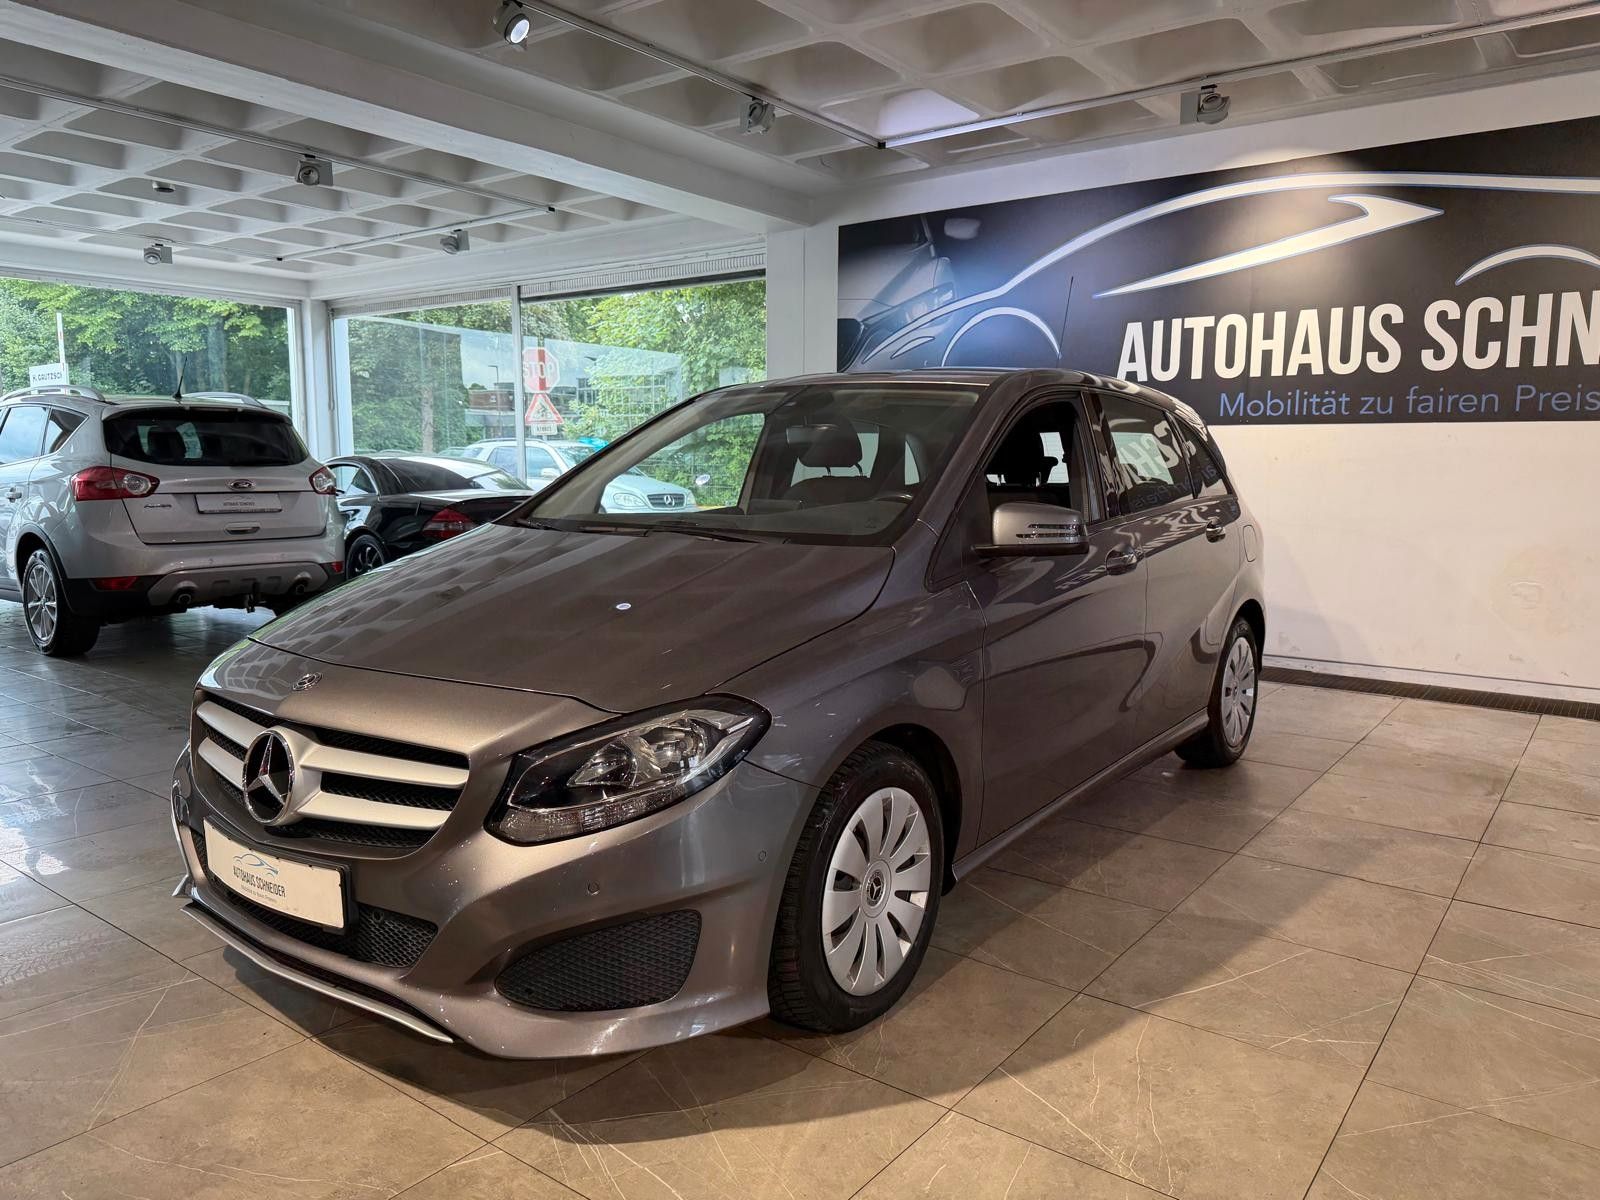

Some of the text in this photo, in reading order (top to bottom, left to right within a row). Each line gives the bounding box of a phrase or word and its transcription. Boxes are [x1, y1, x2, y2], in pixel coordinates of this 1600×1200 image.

[1116, 290, 1600, 382] AUTOHAUS SCHN
[523, 361, 554, 379] STOP
[1219, 384, 1600, 417] Mobilität zu fairen Preis
[255, 875, 286, 898] SCHNEIDER
